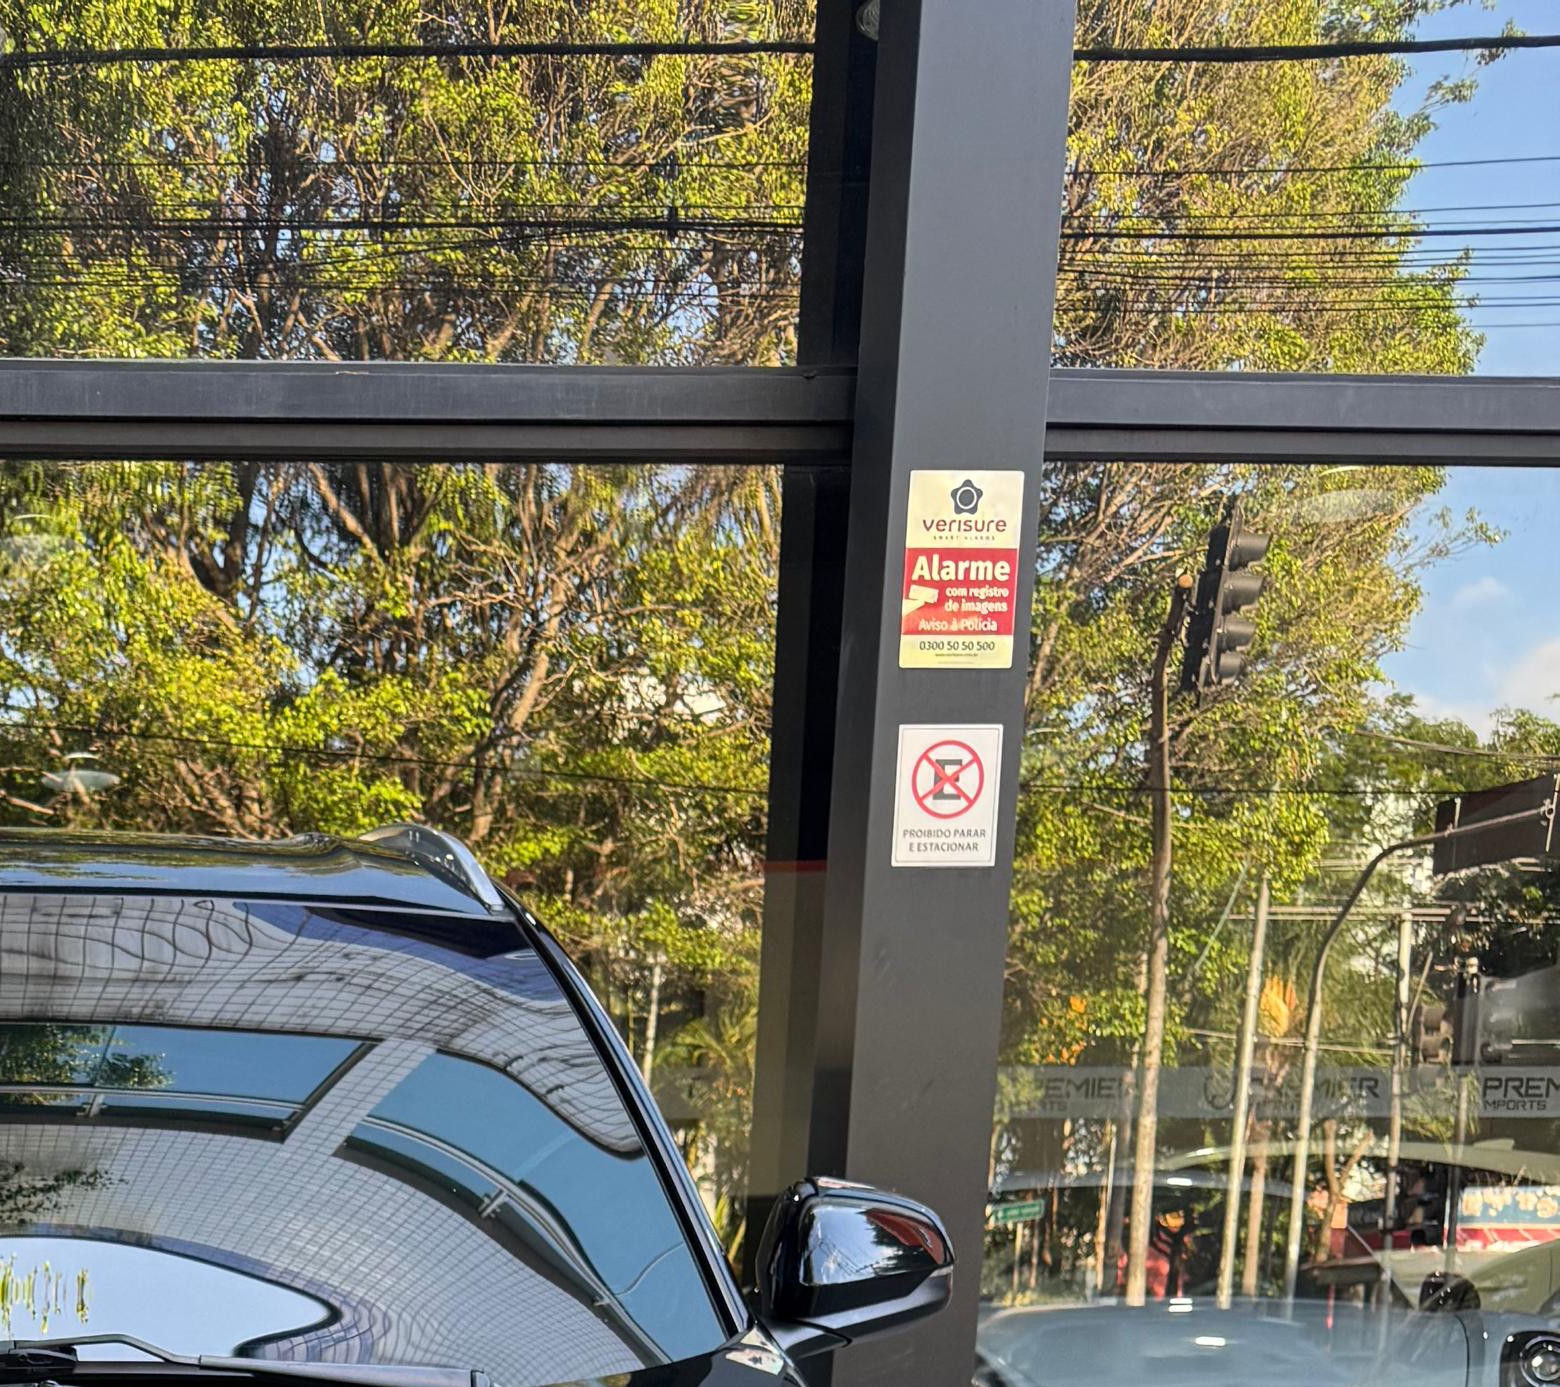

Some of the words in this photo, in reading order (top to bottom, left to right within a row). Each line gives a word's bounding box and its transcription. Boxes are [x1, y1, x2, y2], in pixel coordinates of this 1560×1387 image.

[922, 519, 1007, 533] verisure
[911, 554, 1011, 581] Alarme
[945, 587, 968, 597] com
[969, 585, 1009, 600] registro
[944, 599, 959, 612] de
[961, 599, 1008, 615] imagens
[918, 617, 948, 631] Aviso
[919, 641, 944, 651] 0300
[947, 641, 959, 651] 50
[962, 641, 974, 651] 50
[977, 641, 995, 651] 500
[903, 828, 951, 838] PROIBIDO
[953, 828, 986, 838] PARAR
[909, 843, 914, 852] E
[917, 843, 979, 852] ESTACIONAR
[1483, 1077, 1560, 1098] PREM
[1484, 1099, 1547, 1111] MPORTS
